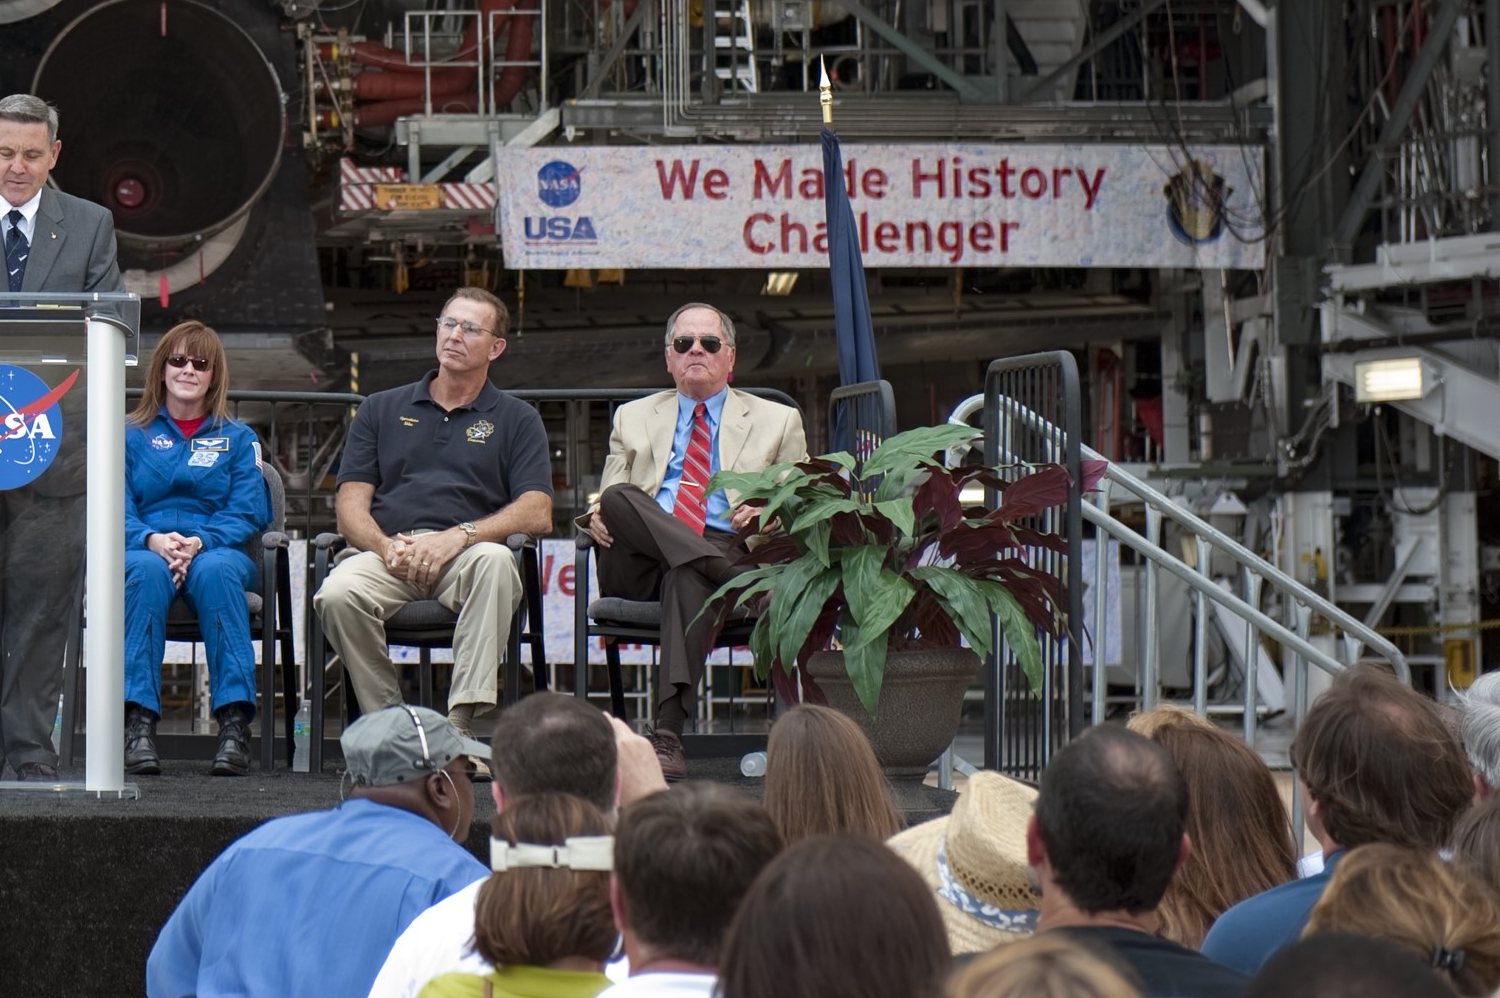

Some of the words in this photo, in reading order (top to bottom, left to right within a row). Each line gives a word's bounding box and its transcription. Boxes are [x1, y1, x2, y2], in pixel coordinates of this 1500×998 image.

[539, 179, 578, 192] NASA
[655, 159, 729, 200] We
[911, 156, 1107, 211] History
[524, 216, 597, 240] USA
[742, 211, 1020, 264] Chalenger
